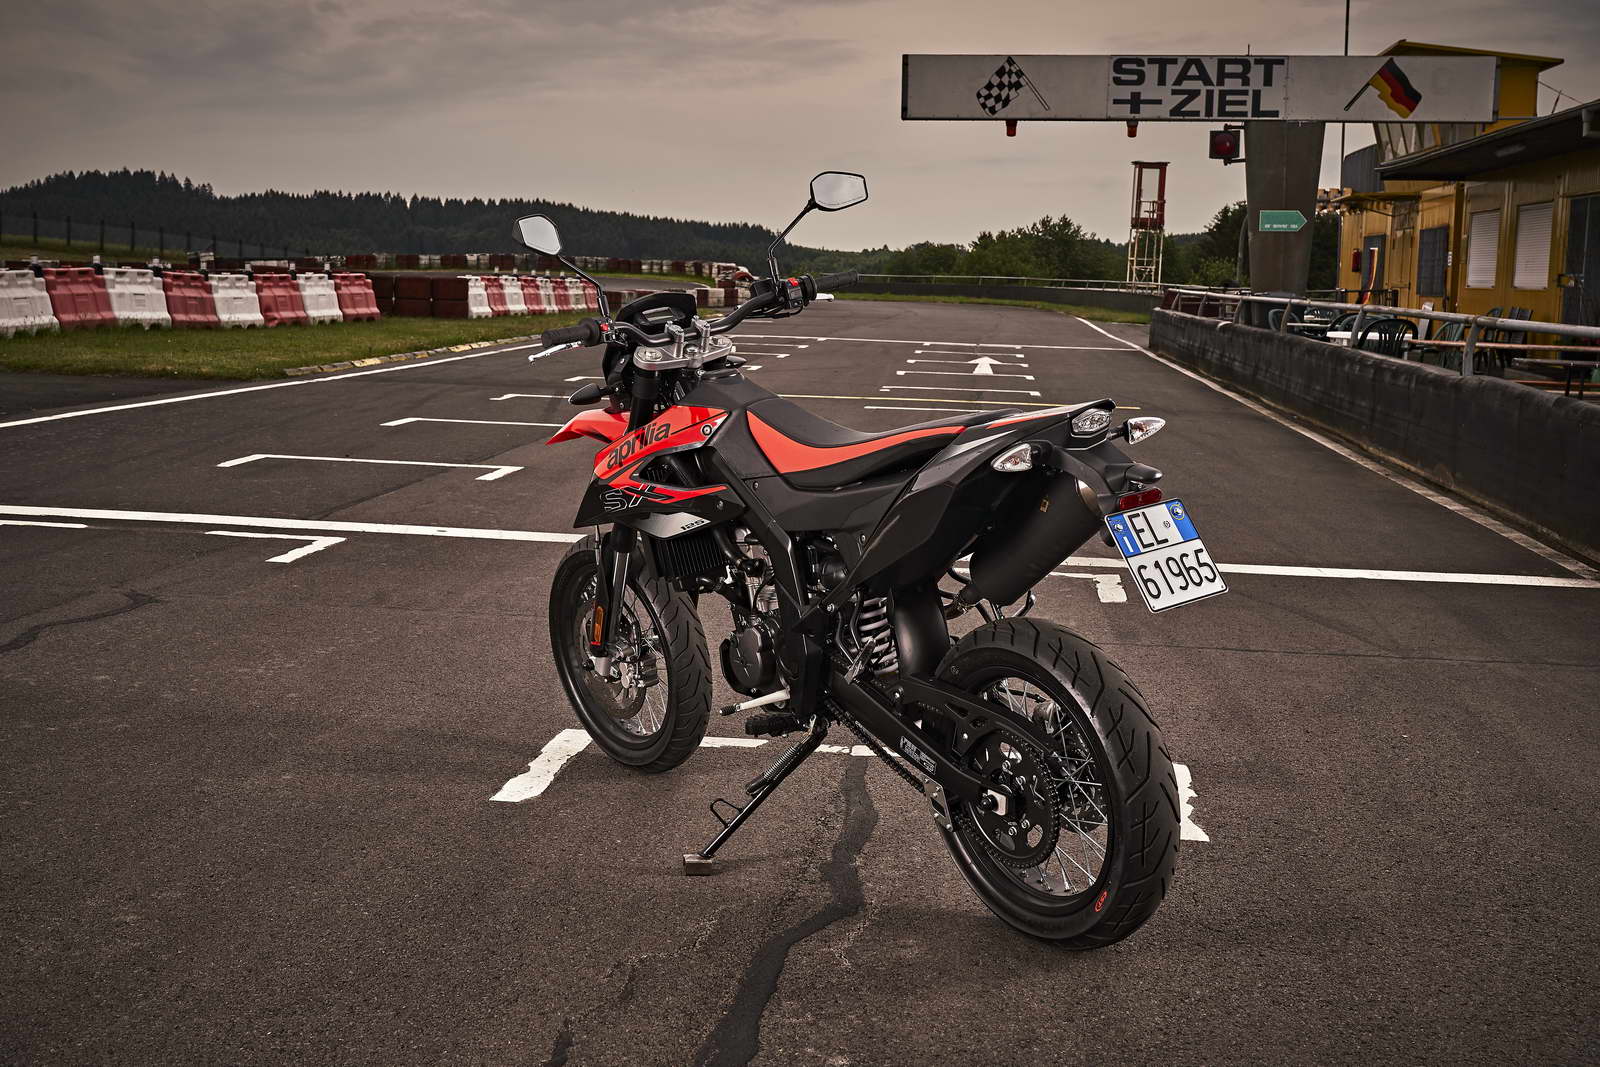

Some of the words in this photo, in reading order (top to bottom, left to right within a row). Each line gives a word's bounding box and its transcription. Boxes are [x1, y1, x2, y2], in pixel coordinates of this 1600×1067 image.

[1112, 57, 1285, 87] START
[606, 422, 671, 470] aprilia
[600, 483, 676, 513] SX
[680, 519, 705, 531] 125
[1127, 511, 1169, 549] EL
[1137, 548, 1217, 600] 61965
